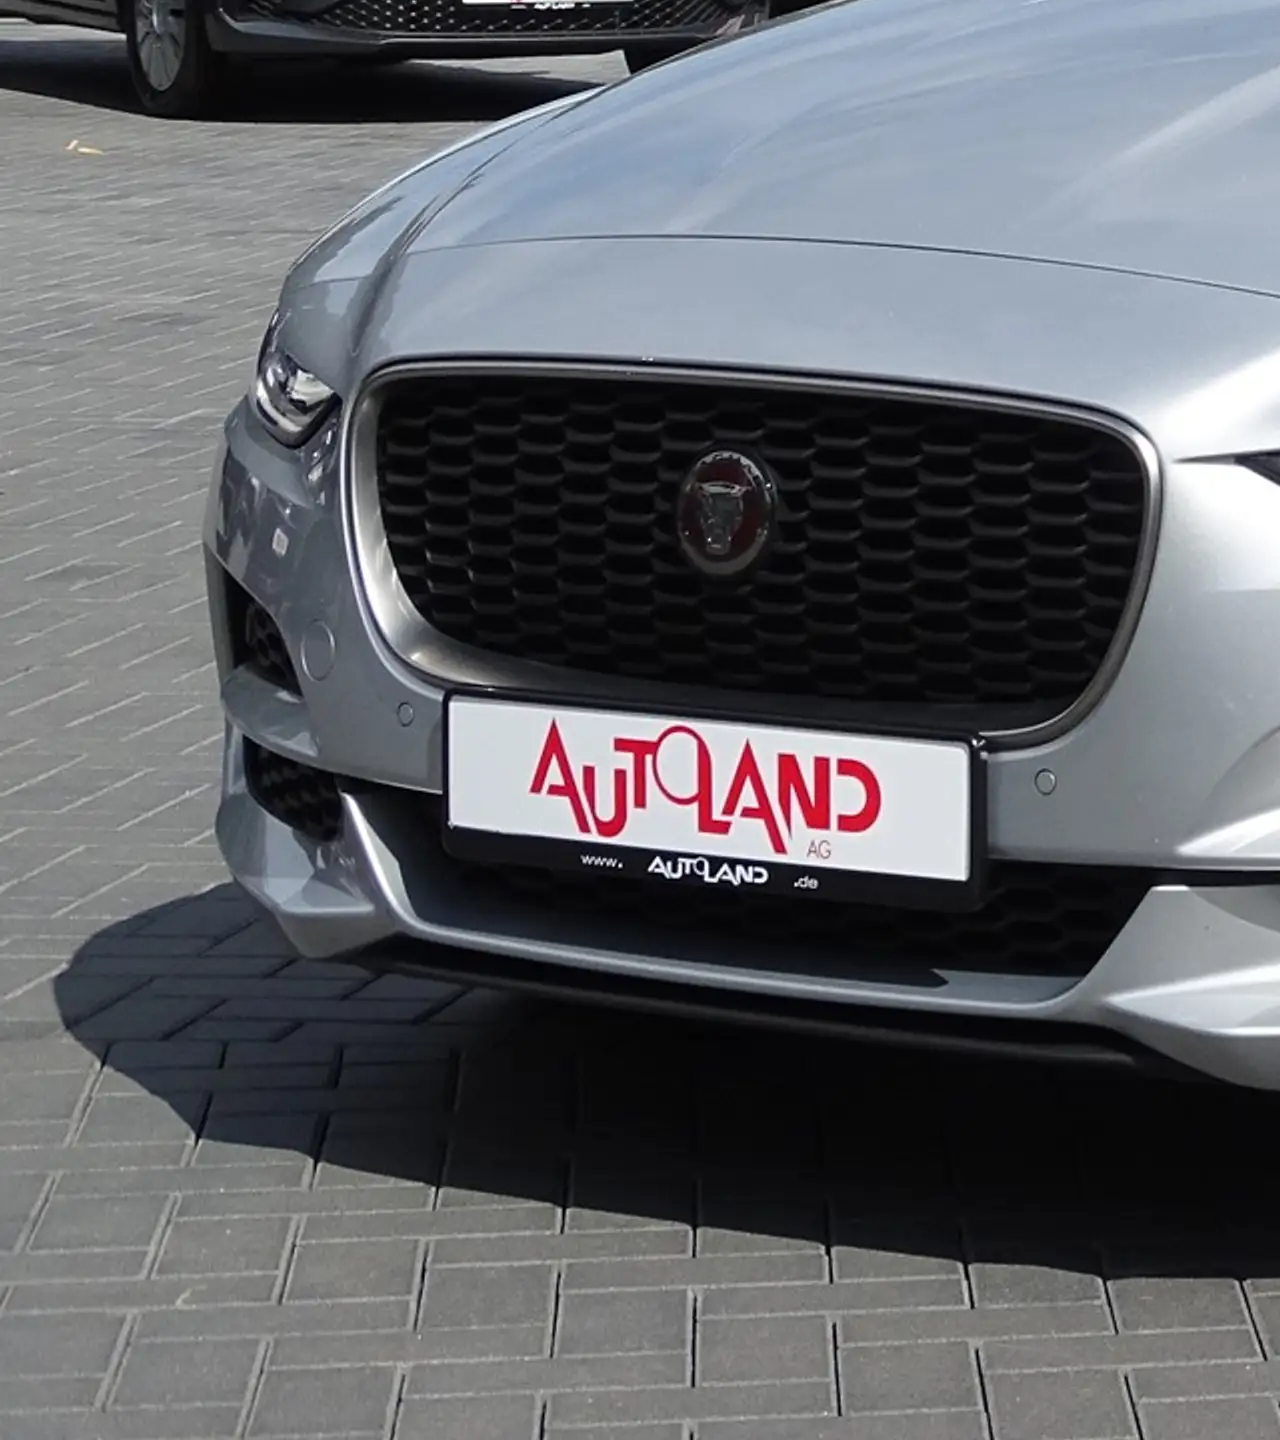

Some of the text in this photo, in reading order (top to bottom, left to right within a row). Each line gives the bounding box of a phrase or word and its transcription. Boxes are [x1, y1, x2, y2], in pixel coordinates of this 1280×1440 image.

[529, 718, 882, 855] AUTOLAND
[806, 841, 833, 860] AG
[580, 855, 819, 890] www. AUTOLAND .de
